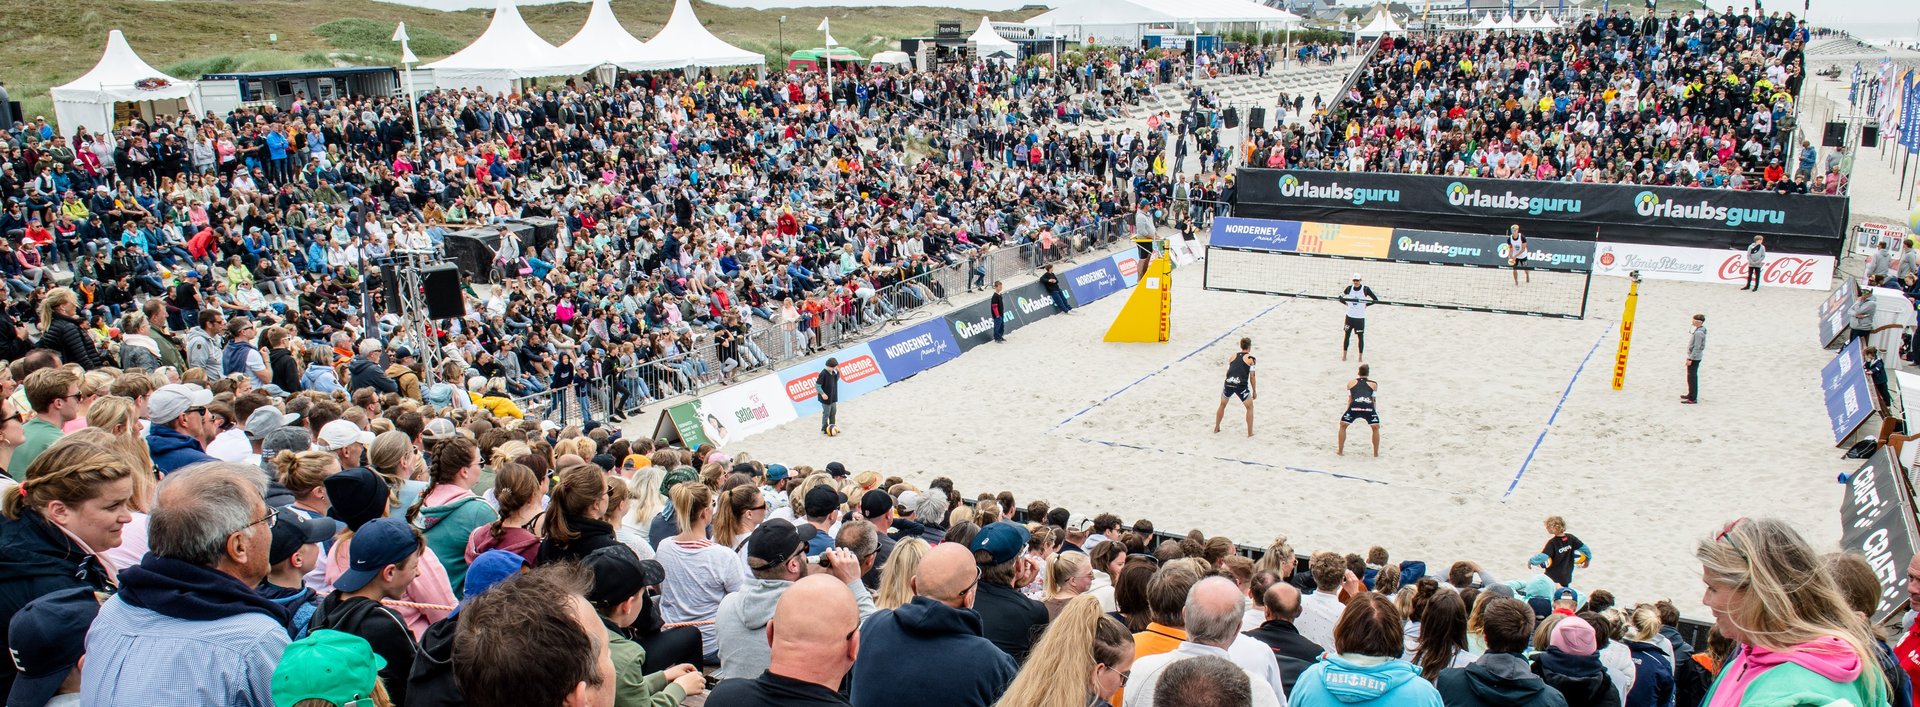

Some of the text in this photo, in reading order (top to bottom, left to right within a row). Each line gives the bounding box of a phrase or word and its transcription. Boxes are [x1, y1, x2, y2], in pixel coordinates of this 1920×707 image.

[1279, 180, 1400, 206] Urlaubsguru
[1447, 188, 1582, 216] Urlaubsguru
[1636, 197, 1786, 227] Urlaubsguru
[1225, 224, 1279, 236] NORDERNEY
[1870, 235, 1900, 249] 9 7
[1399, 238, 1482, 258] Urlaubsguru
[1498, 244, 1587, 266] Uubsguru
[1718, 254, 1819, 286] Coc-Cola
[959, 310, 1015, 339] Urlaubsru
[885, 332, 934, 360] NORDERNEY
[734, 403, 770, 424] sebamed
[1852, 465, 1881, 516] CRAFT
[1862, 527, 1898, 588] CRAFT
